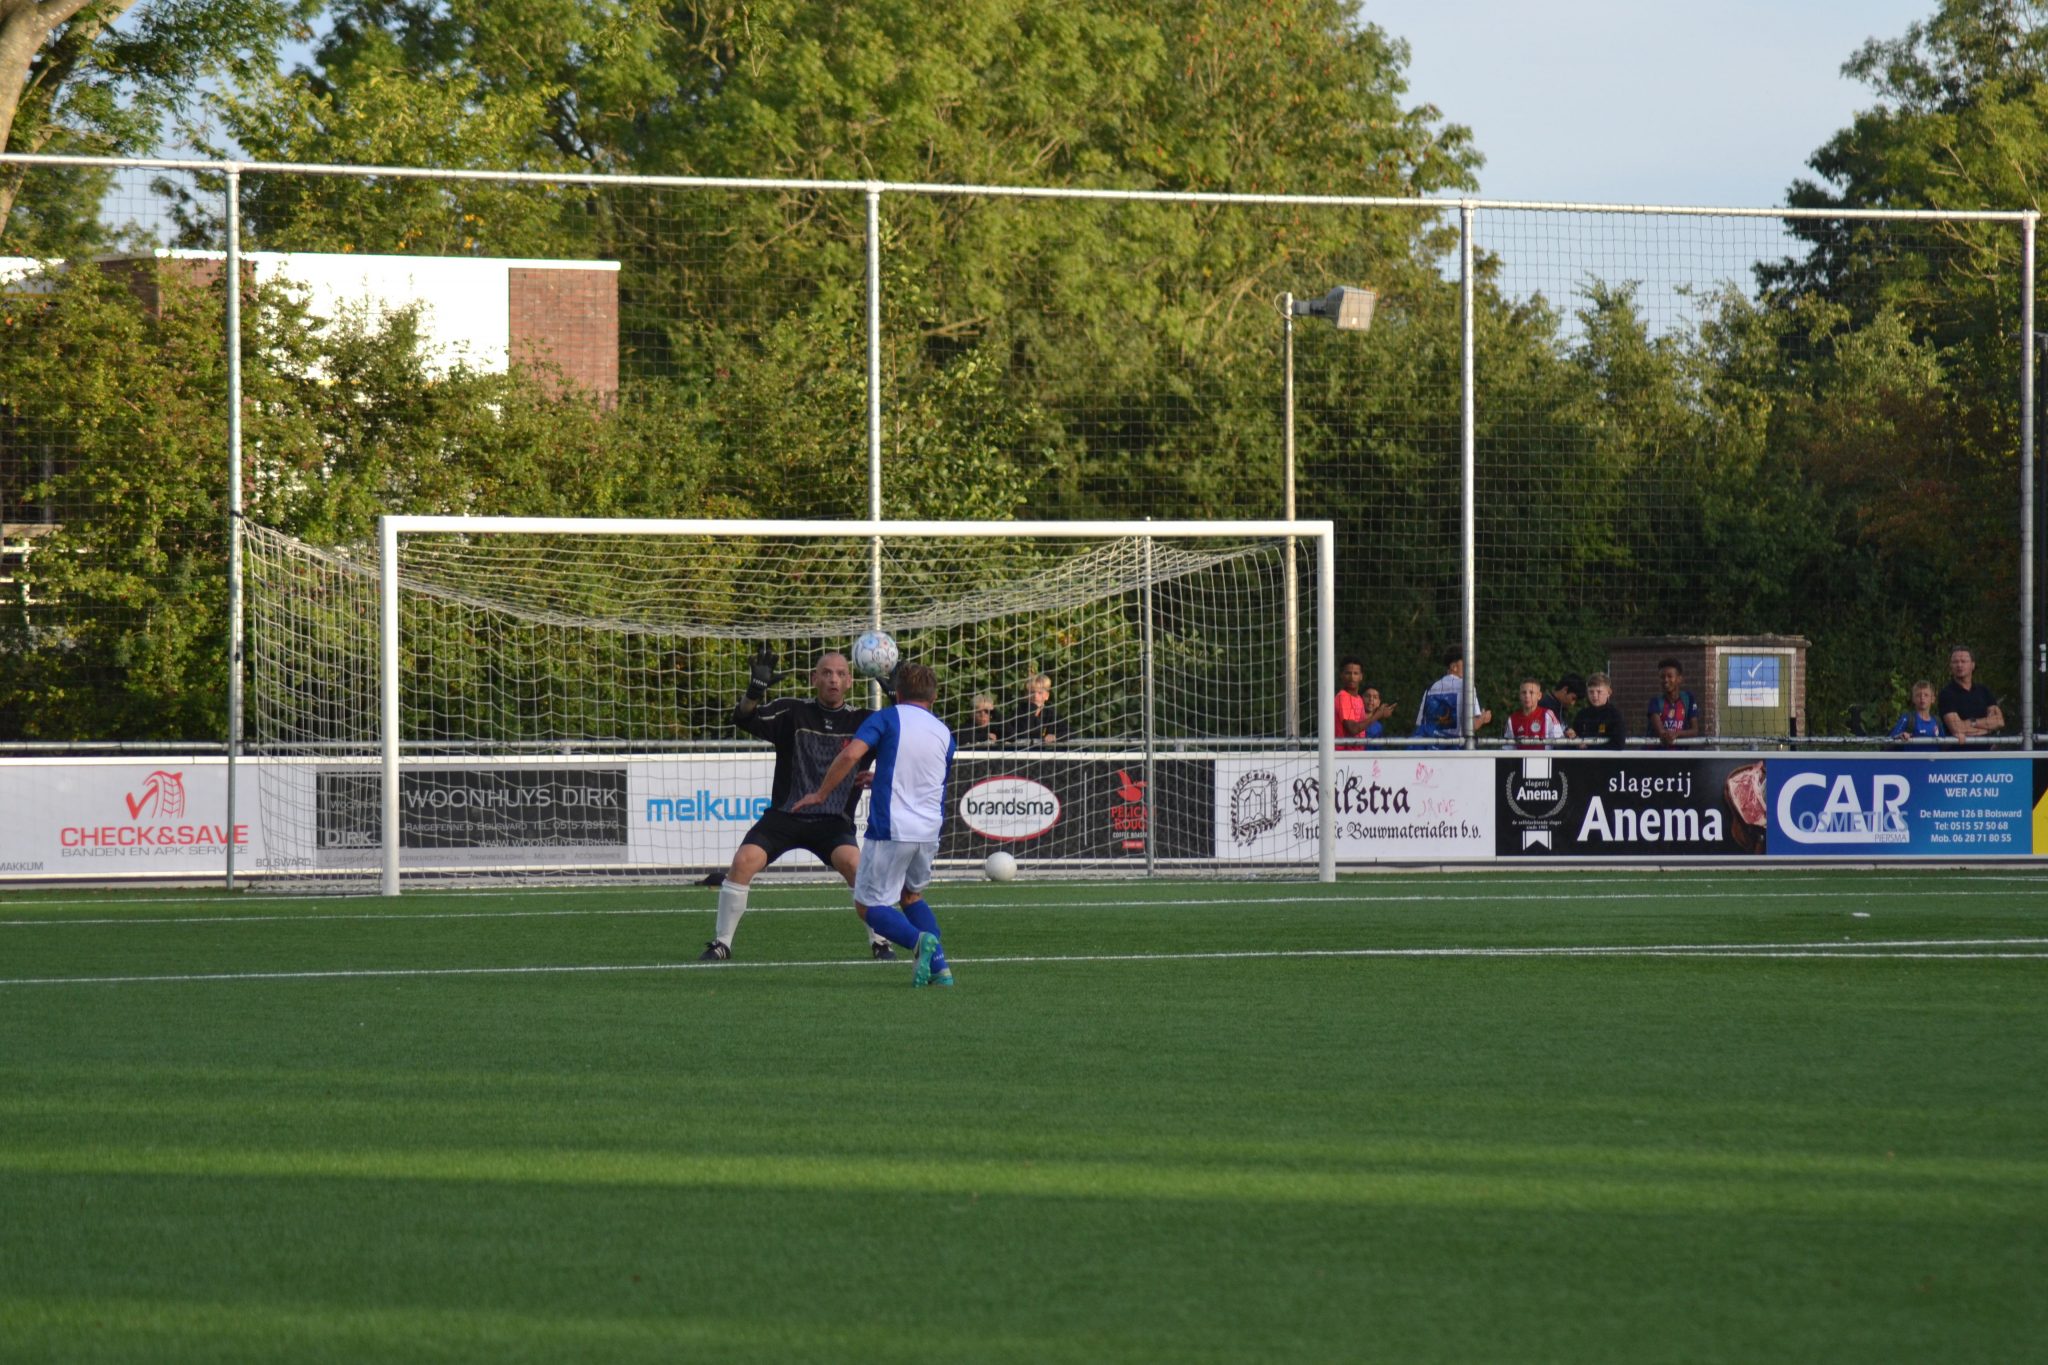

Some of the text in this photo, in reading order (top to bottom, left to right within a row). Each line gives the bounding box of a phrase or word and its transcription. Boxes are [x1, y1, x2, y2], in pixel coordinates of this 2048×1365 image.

[1525, 779, 1550, 789] slagerij
[1609, 771, 1692, 798] slagerij
[1928, 773, 2014, 783] MAKKET JO AUTO
[405, 787, 618, 808] WOONHUYS DIRK
[1516, 786, 1559, 801] Anema
[1945, 787, 1967, 798] WER
[1969, 787, 1982, 798] AS
[967, 797, 1054, 815] brandsma
[1777, 772, 1911, 844] CAR
[1920, 809, 2022, 818] De Marne 126 B Bolsward
[477, 820, 528, 831] BOLSWARD
[1577, 796, 1724, 842] Anema
[1798, 810, 1909, 833] OSMETICS
[1935, 821, 2009, 830] Tel: 0515 57 50 68
[60, 824, 249, 847] CHECK&SAVE
[1347, 820, 1458, 840] Bouwmaterialen
[1461, 819, 1482, 839] b.v.
[324, 830, 373, 847] DIRK
[1931, 833, 2012, 843] Mob. 06 28 71 80 55
[61, 844, 248, 858] BANDEN EN APK SERVCE
